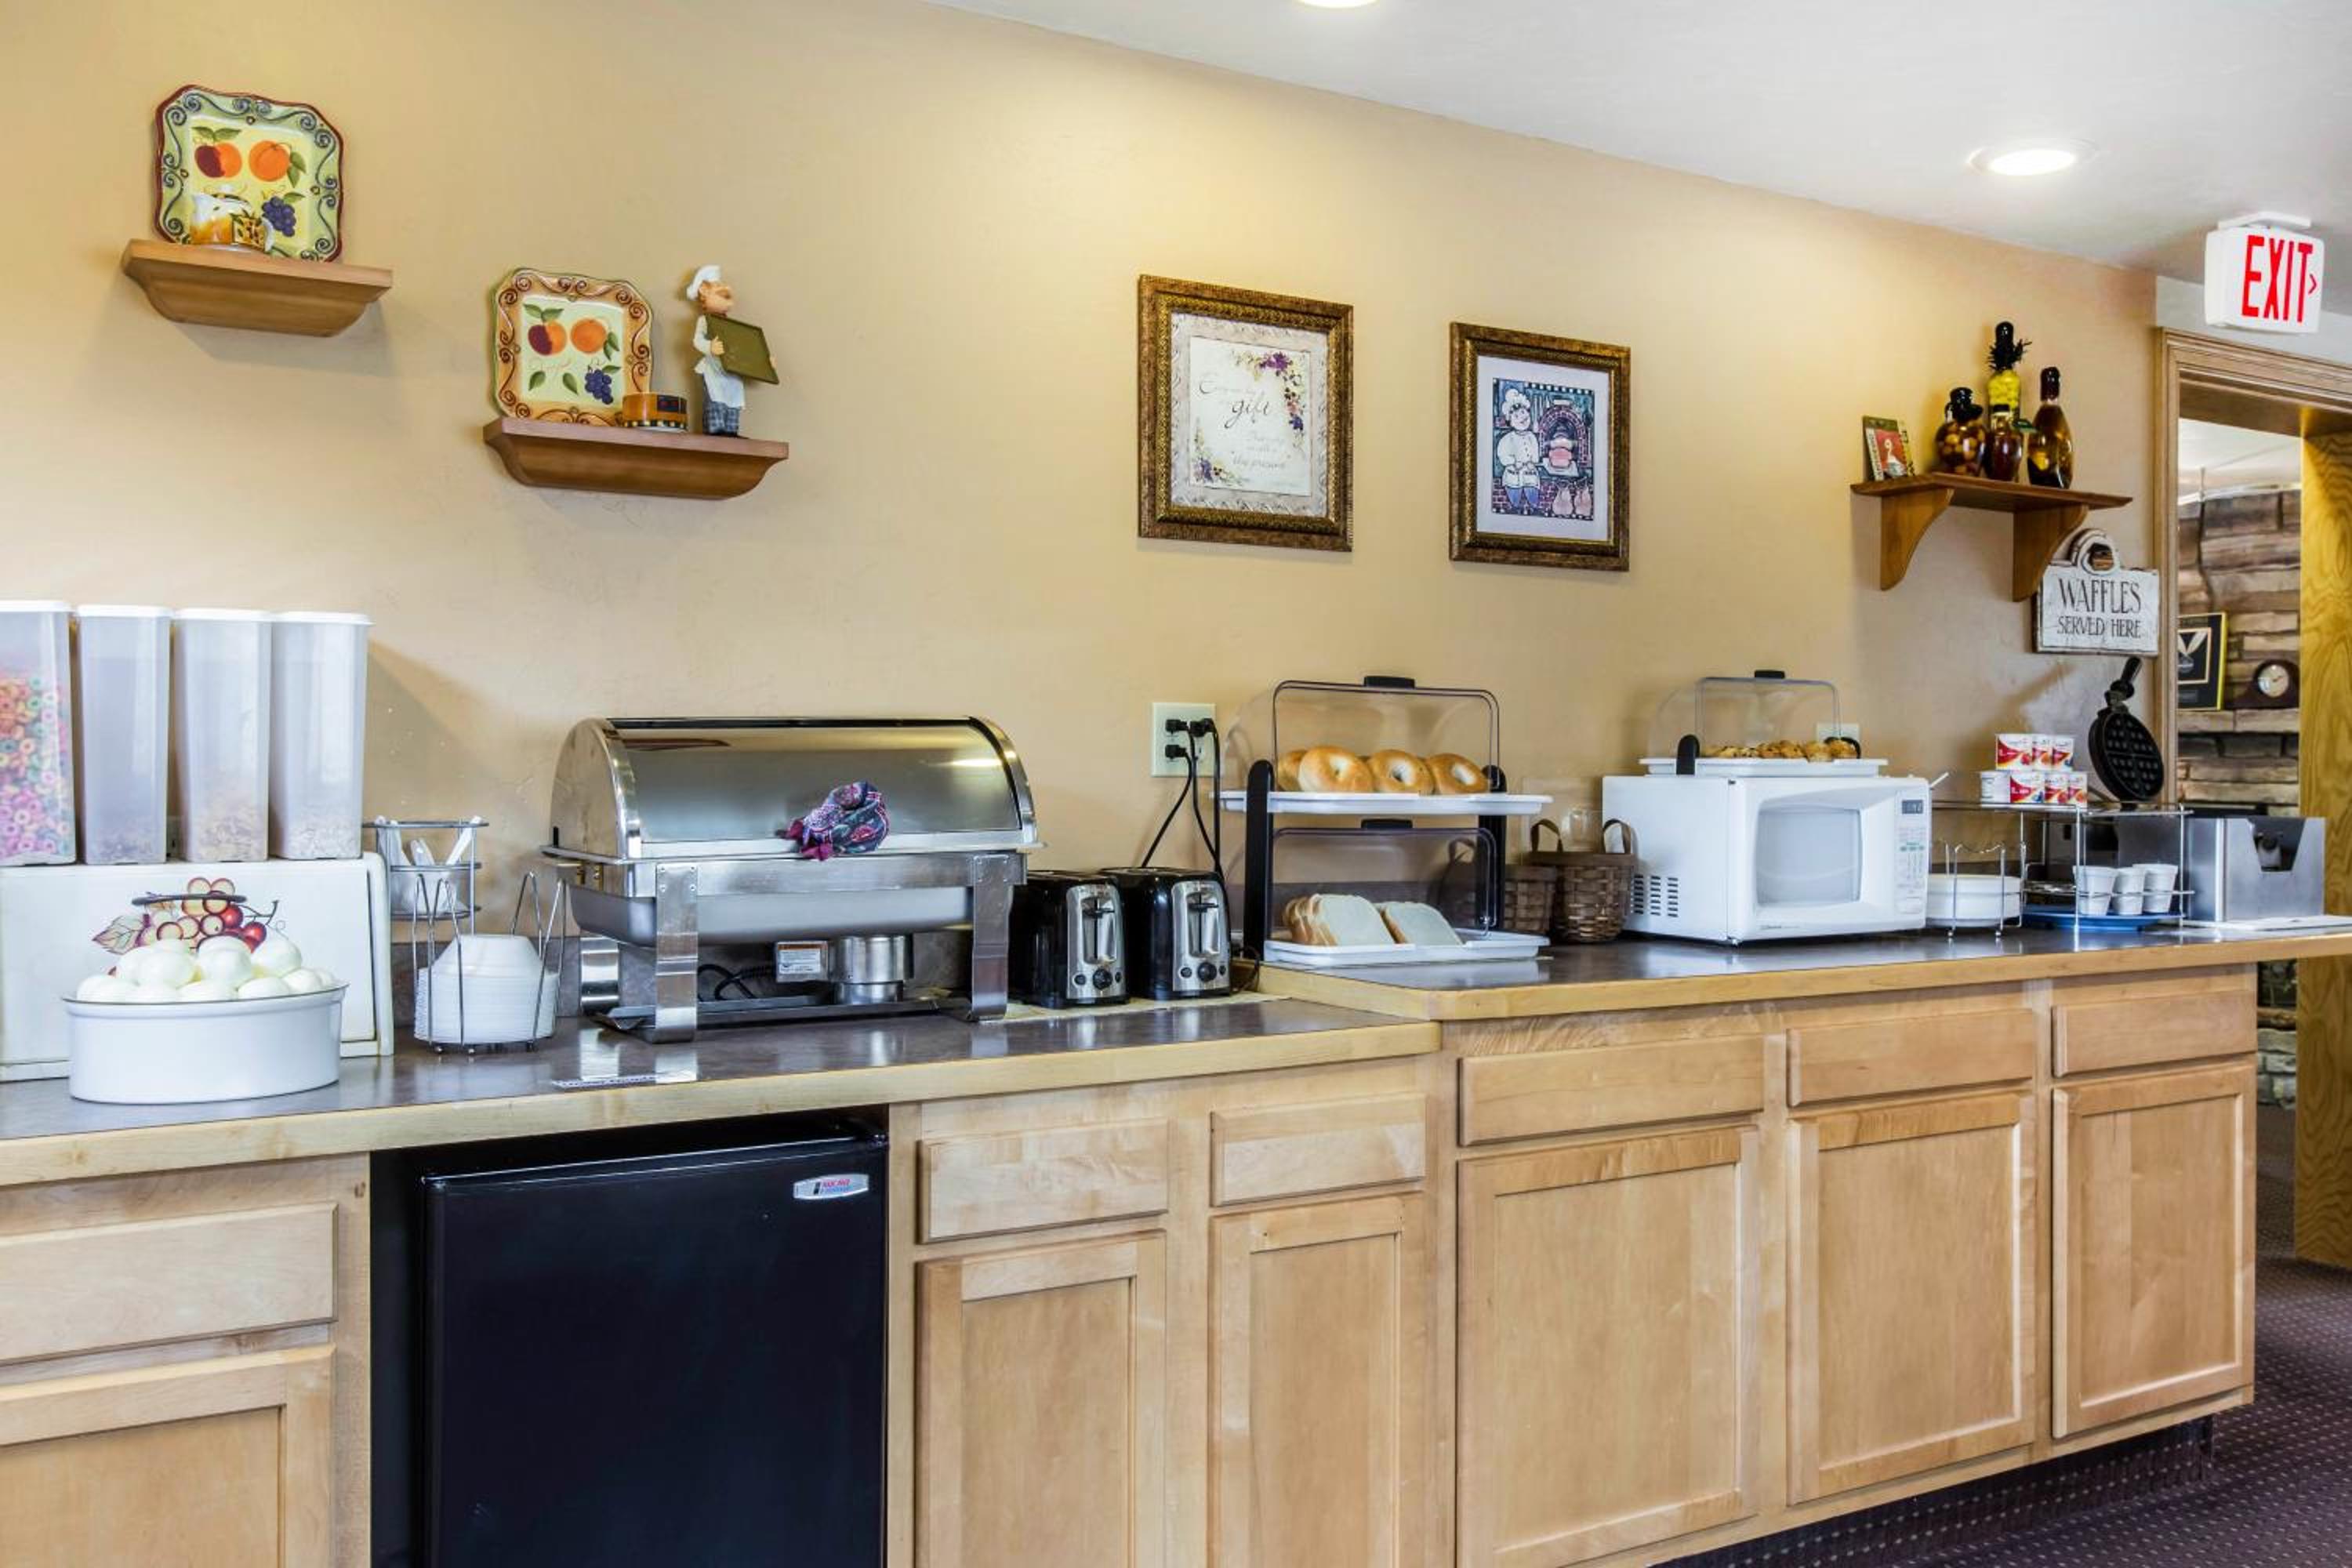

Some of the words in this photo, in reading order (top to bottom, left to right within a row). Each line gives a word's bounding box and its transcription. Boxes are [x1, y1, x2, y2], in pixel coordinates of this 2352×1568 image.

[2241, 234, 2314, 323] EXIT
[2058, 578, 2141, 614] WAFFLES
[2057, 615, 2105, 636] SERVED
[2111, 619, 2142, 639] HERE
